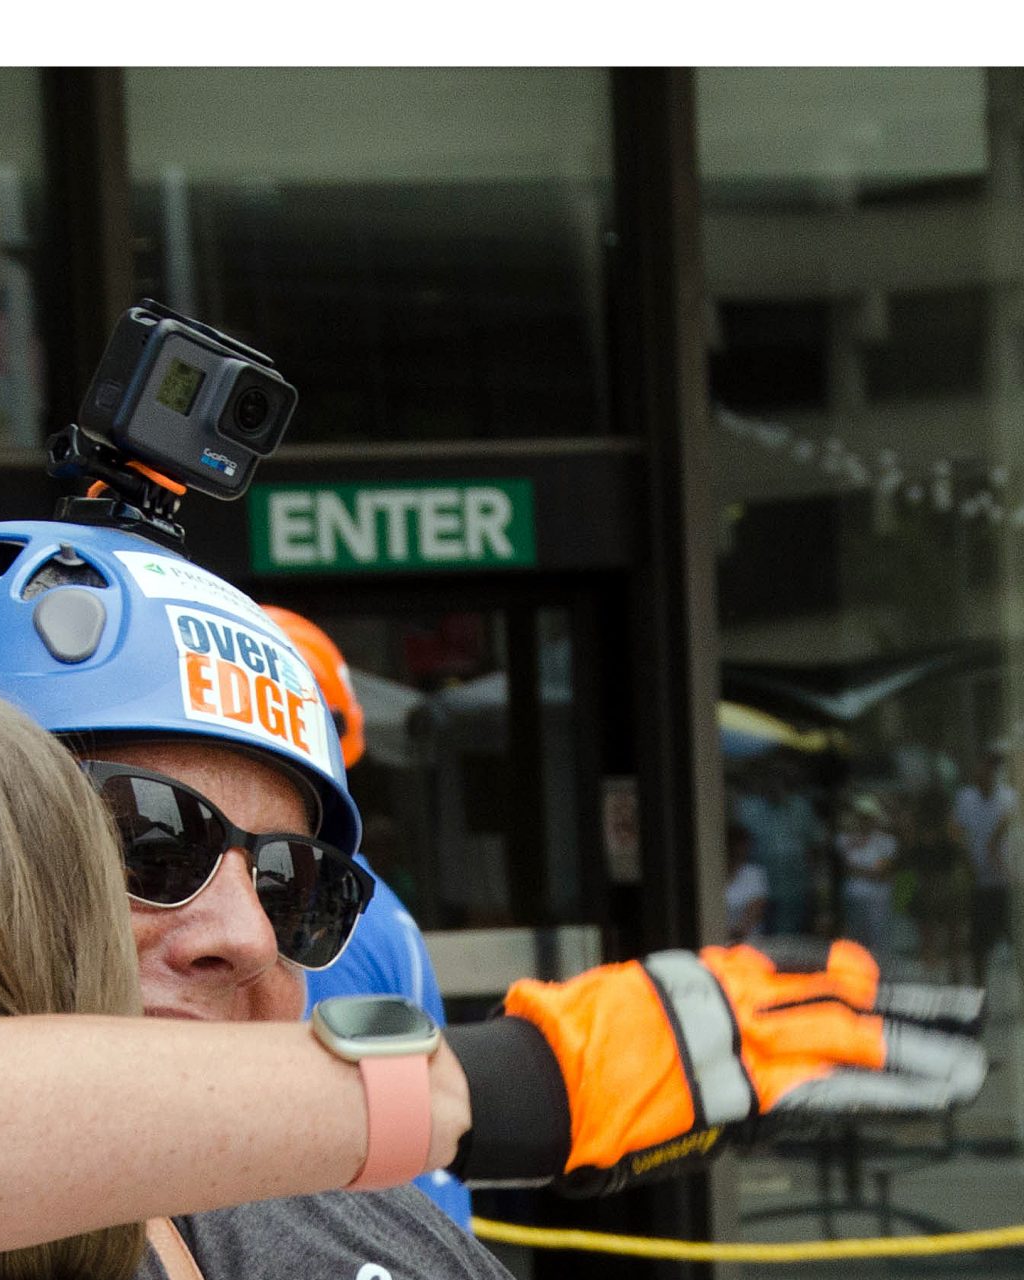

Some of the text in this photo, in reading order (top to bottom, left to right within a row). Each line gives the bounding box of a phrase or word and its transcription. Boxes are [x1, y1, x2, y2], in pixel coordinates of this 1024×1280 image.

[268, 486, 514, 565] ENTER
[177, 614, 281, 683] over
[185, 651, 312, 754] EDGE
